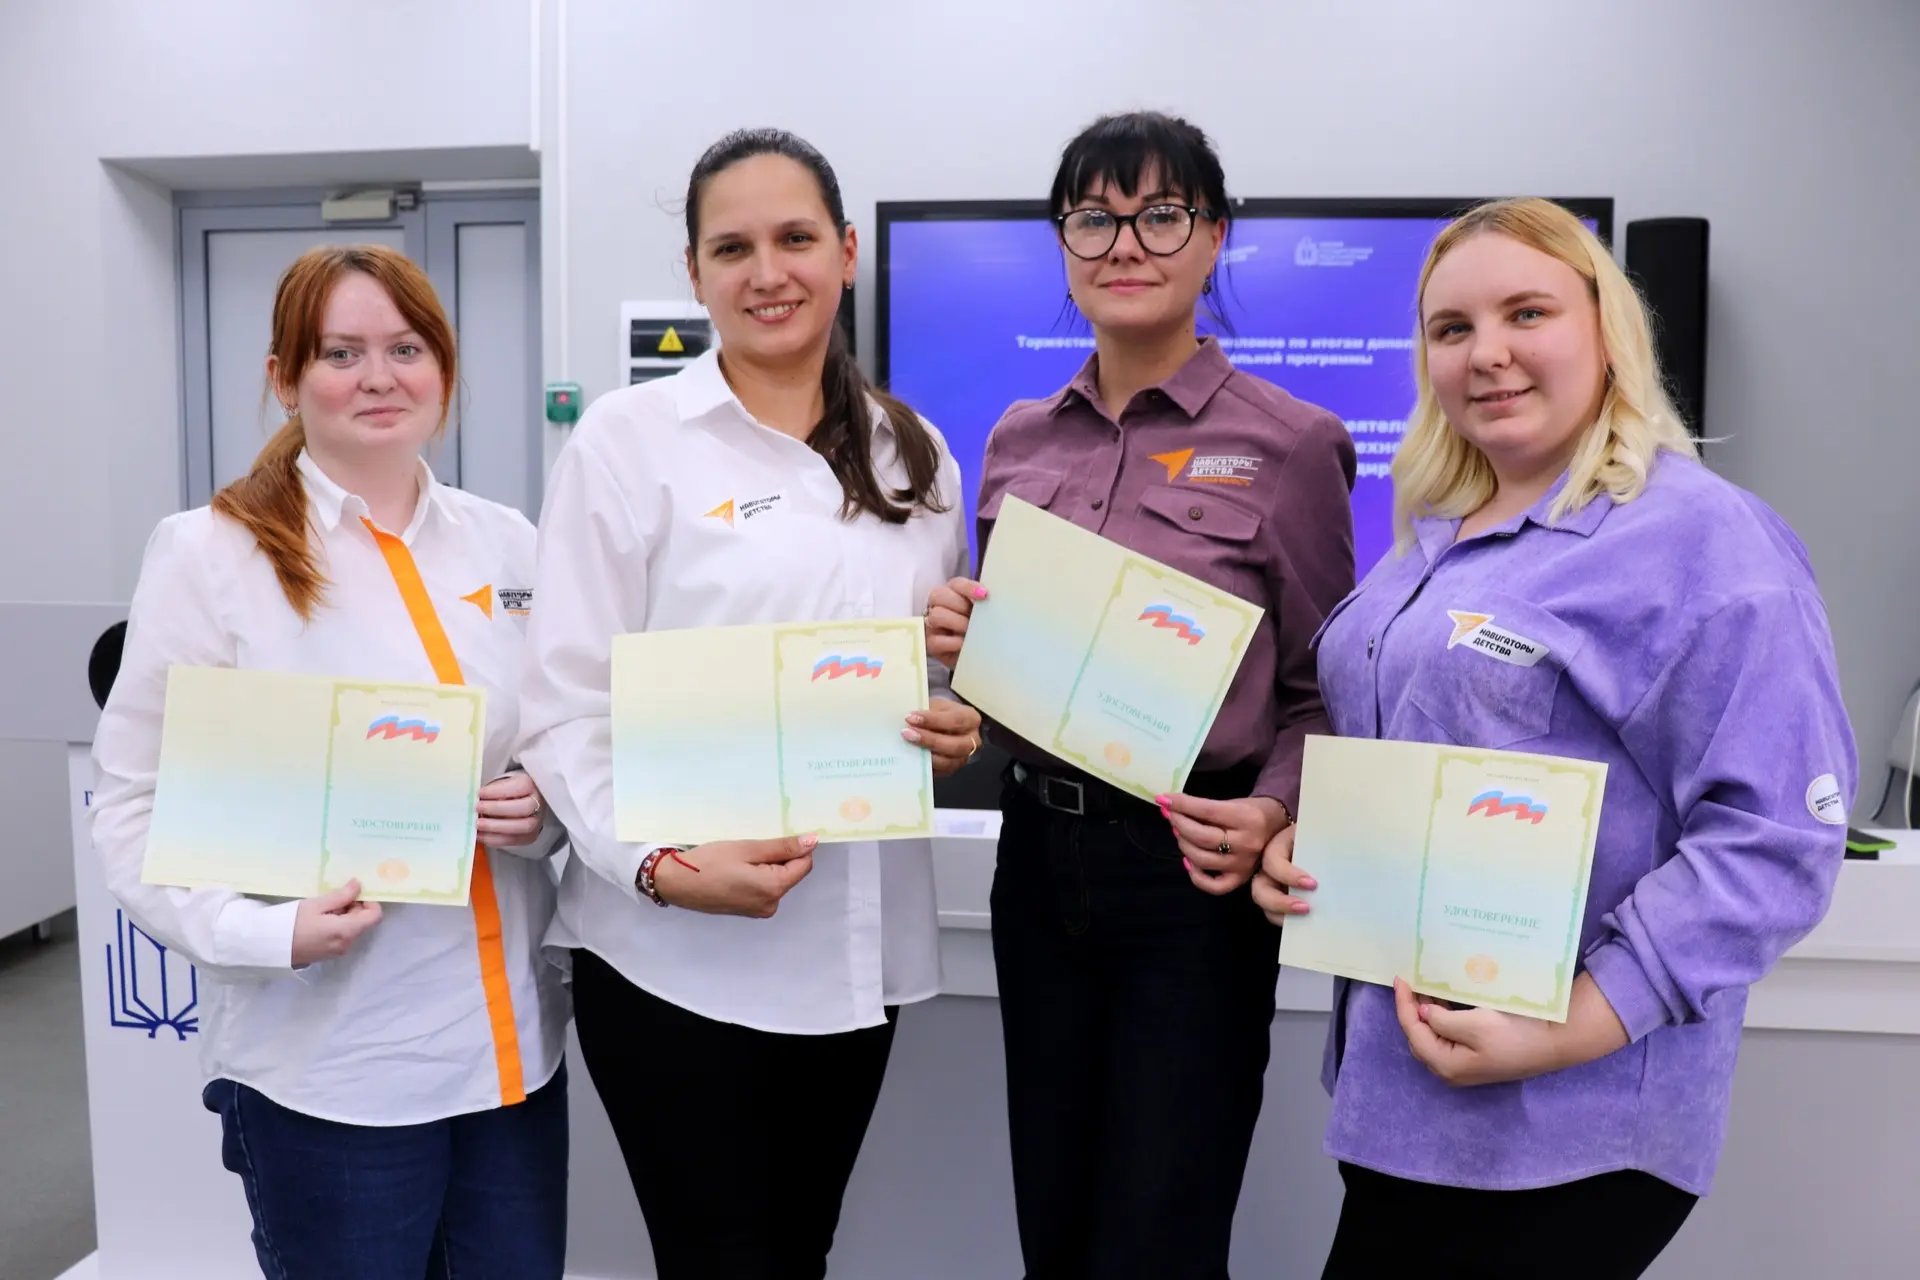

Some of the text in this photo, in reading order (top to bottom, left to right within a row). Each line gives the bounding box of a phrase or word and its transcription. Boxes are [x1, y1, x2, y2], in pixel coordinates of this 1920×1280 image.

[1193, 458, 1253, 467] НАВИГАТОРЫ
[1190, 467, 1234, 476] ДЕТСТВА
[739, 494, 781, 511] НАВИГАТОРЫ
[744, 504, 773, 520] ДЕТСТВА
[1472, 637, 1512, 657] ДЕТСТВА
[1479, 628, 1535, 655] НАВИГАТОРЫ
[807, 756, 898, 770] УДОСТОВЕРЕНИЕ
[351, 818, 442, 833] УДОСТОВЕРЕНИЕ
[1444, 903, 1542, 929] УДОСТОВЕРЕНИЕ
